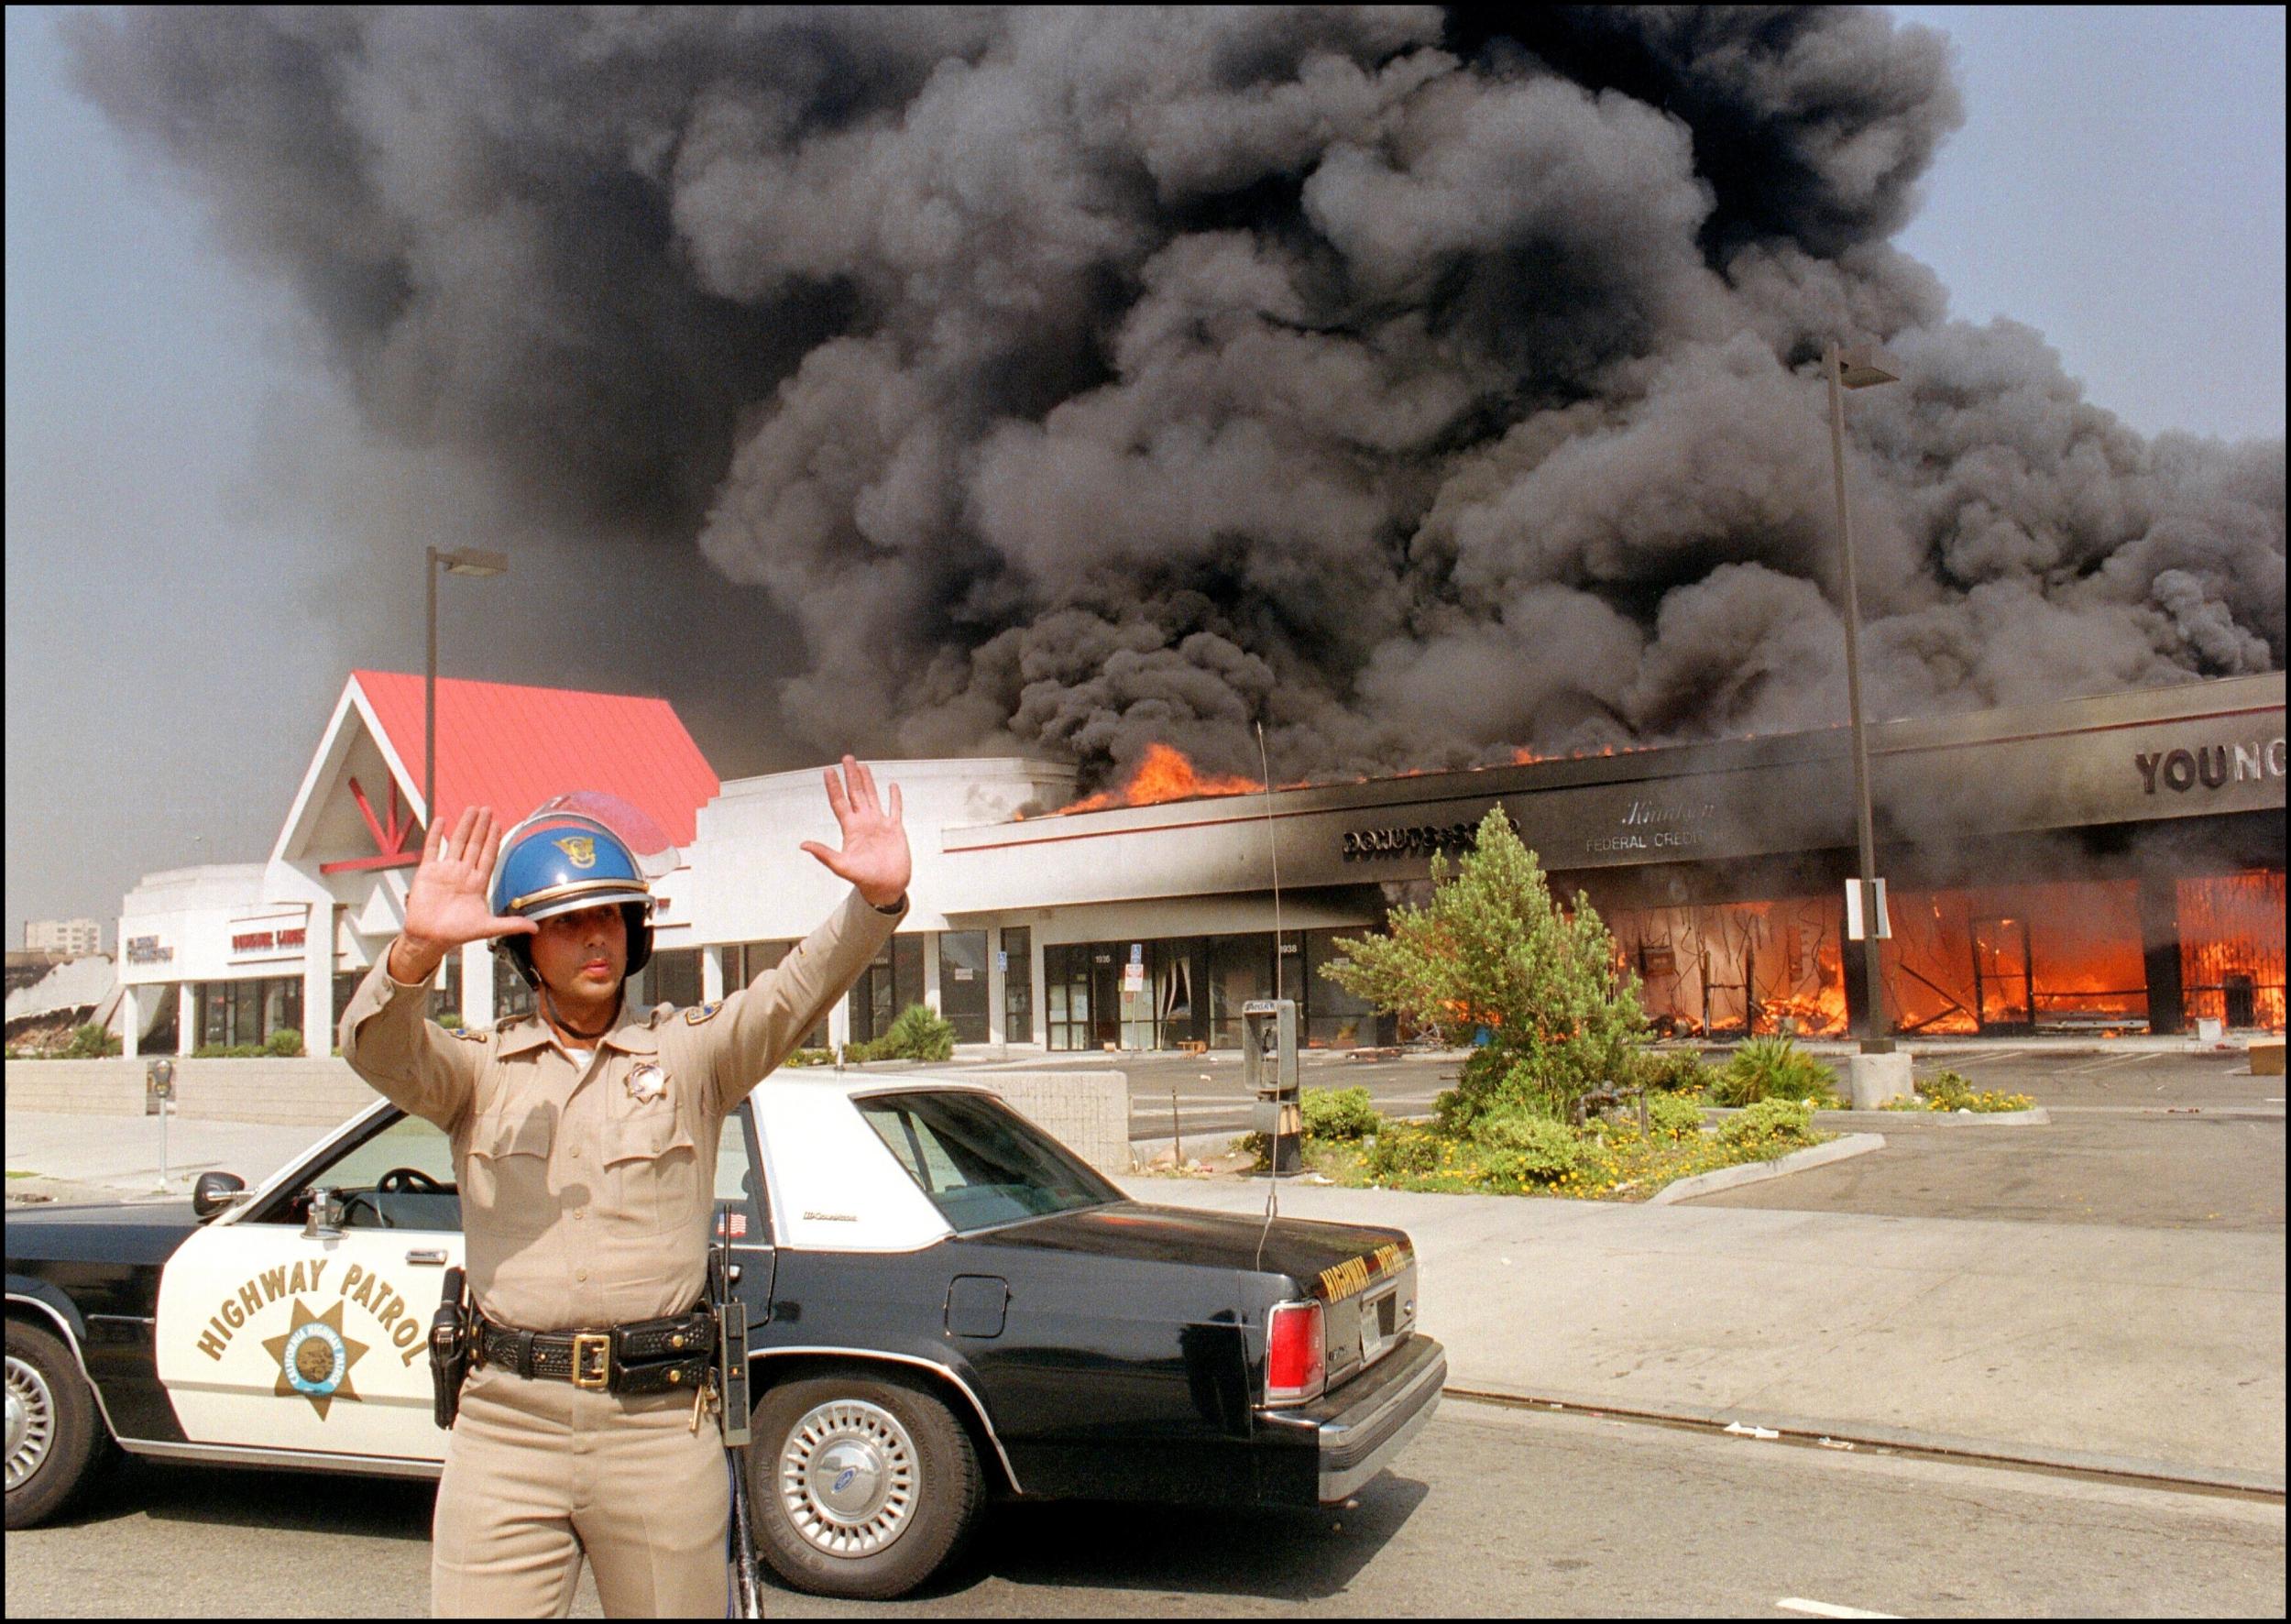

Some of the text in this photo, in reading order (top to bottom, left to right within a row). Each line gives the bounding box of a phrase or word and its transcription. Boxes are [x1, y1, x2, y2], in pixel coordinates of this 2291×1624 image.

[2135, 738, 2286, 795] YOUNG
[1586, 835, 1647, 852] FEDERAL
[1319, 1255, 1370, 1305] HIGHWAY
[197, 1259, 429, 1367] HIGHWAY PATROL
